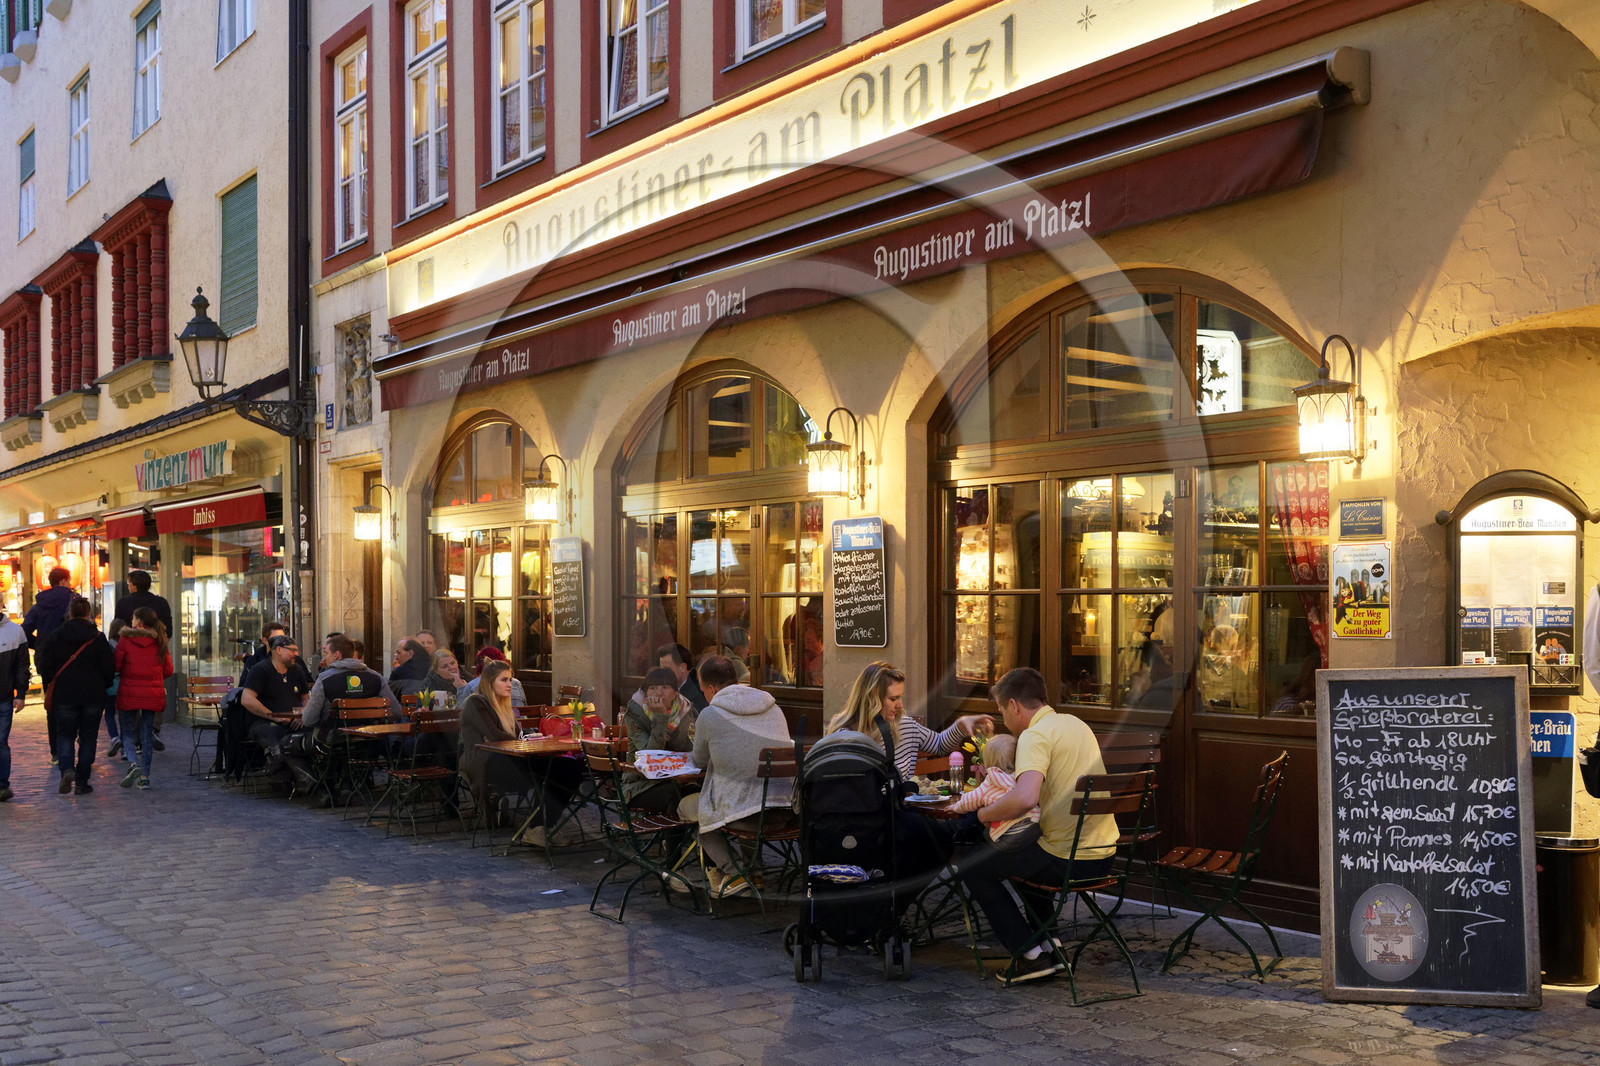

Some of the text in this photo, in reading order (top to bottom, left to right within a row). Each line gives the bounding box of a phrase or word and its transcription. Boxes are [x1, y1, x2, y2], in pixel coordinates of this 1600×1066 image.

[748, 111, 823, 184] am
[840, 14, 1018, 148] Platzl
[874, 192, 1091, 281] Augustiner am Platzl
[613, 287, 746, 347] Augustiner am Platzl
[438, 347, 530, 393] Augustiner am Platzl
[327, 405, 332, 418] 5
[135, 440, 229, 492] vinzenzmurr
[193, 507, 216, 526] Imbiss
[1352, 609, 1382, 619] Der Weg
[1363, 618, 1382, 628] guter
[1343, 626, 1382, 636] Gastlichkeit
[1337, 690, 1470, 711] Aus unserer
[1334, 733, 1362, 749] Mo
[1408, 731, 1431, 748] ab
[1335, 752, 1365, 767] Sa
[1358, 770, 1458, 798] Grillhendl
[1386, 825, 1453, 848] Pommes
[1460, 830, 1518, 852] 14,50€
